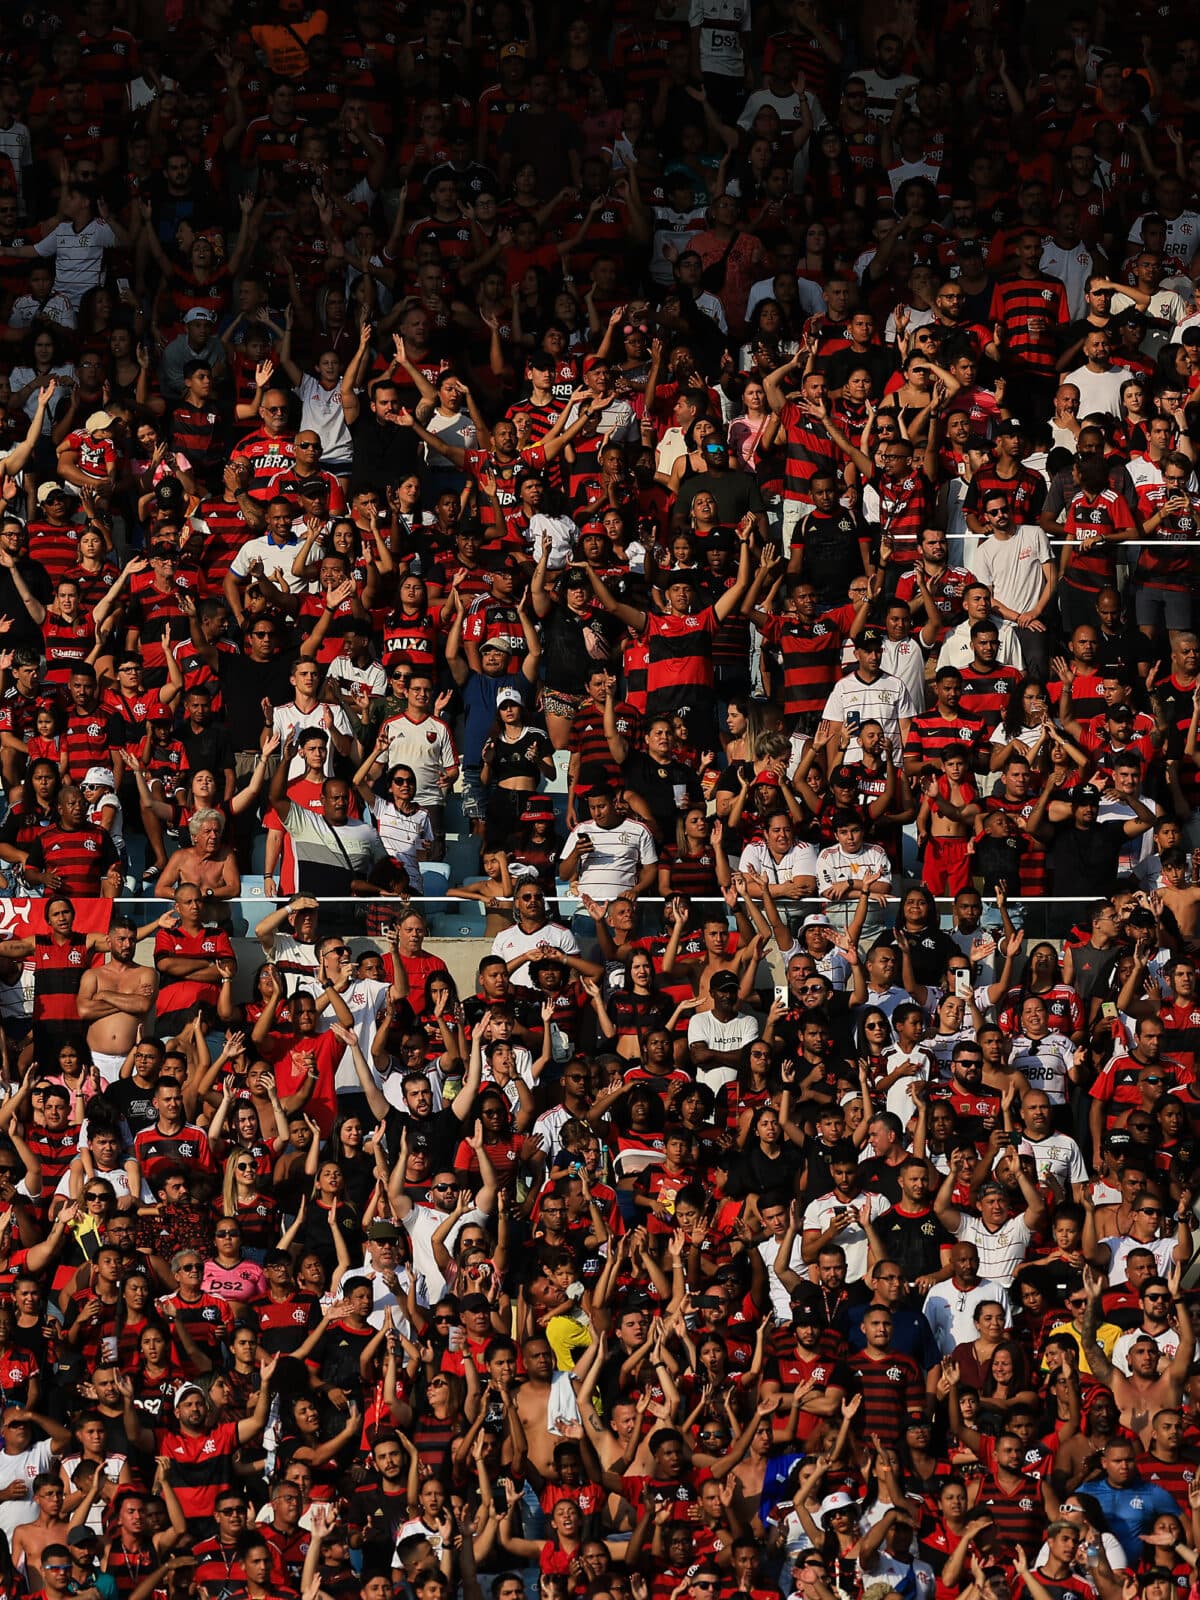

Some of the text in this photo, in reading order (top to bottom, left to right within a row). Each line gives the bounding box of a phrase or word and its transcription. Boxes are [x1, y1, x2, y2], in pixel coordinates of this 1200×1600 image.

[251, 456, 297, 470] UBRAX
[387, 638, 428, 652] CAIXA
[510, 636, 526, 650] BR
[1026, 1067, 1055, 1081] BRB
[209, 1280, 243, 1292] bs2
